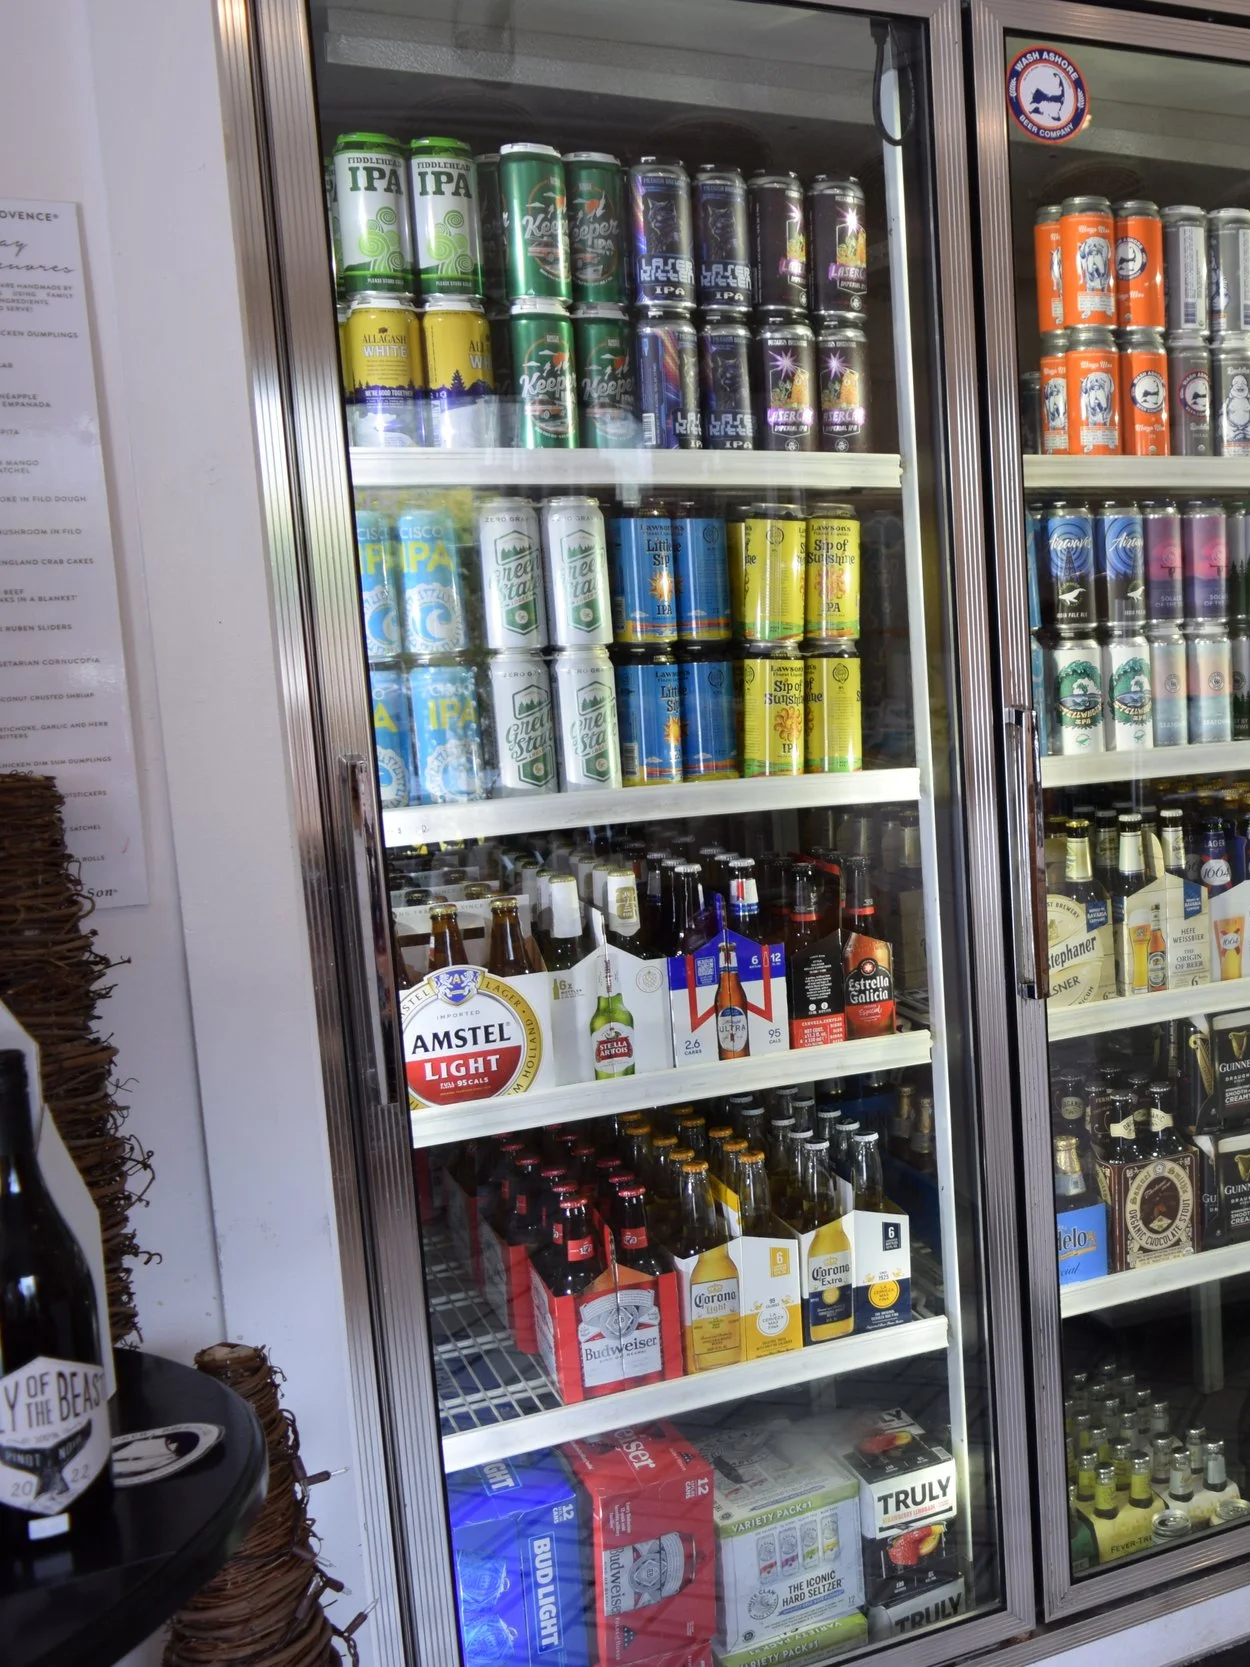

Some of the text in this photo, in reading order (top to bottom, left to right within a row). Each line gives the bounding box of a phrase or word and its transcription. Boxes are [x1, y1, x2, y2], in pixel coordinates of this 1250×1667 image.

[1015, 51, 1079, 80] WASH ASHORE
[1019, 114, 1075, 139] BEER COMPANY
[348, 166, 404, 195] IPA
[418, 170, 473, 198] IPA
[655, 286, 686, 296] IPA
[715, 291, 744, 301] IPA
[27, 330, 78, 338] DUMPLINGS
[362, 335, 408, 344] ALLAGASH
[363, 345, 409, 357] WHITE
[725, 440, 752, 449] IPA
[835, 539, 850, 552] of
[67, 557, 94, 565] CAKES
[807, 552, 856, 566] Sunshine
[774, 679, 794, 693] Sip
[427, 699, 478, 731] IPA
[1204, 838, 1225, 848] LAGER
[1202, 864, 1231, 879] 1664
[1055, 902, 1080, 919] BREWERY
[1180, 927, 1196, 935] HEFE
[1172, 934, 1204, 944] WEISSBIER
[751, 955, 759, 965] 6
[770, 952, 782, 962] 12
[1176, 952, 1203, 962] ORIGIN
[1186, 961, 1204, 969] BEER
[848, 975, 889, 991] Estrella
[485, 980, 521, 1007] LAGER
[849, 988, 889, 1004] Galicia
[436, 1009, 481, 1021] IMPORTED
[720, 1024, 746, 1033] ULTRA
[768, 1028, 782, 1038] 95
[522, 1018, 537, 1079] HOLLAND
[600, 1041, 628, 1051] STELLA
[684, 1039, 701, 1050] 2.6
[600, 1047, 628, 1057] ARTOIS
[423, 1054, 500, 1081] LIGHT
[468, 1076, 489, 1085] CALS
[1225, 1089, 1248, 1098] SMOOTH
[1129, 1198, 1191, 1247] ORGANIC CHOCOLATE STOUT
[888, 1226, 895, 1239] 6
[776, 1251, 783, 1264] 6
[811, 1263, 850, 1282] Corona
[821, 1277, 843, 1287] Extra
[694, 1290, 737, 1310] Corona
[584, 1336, 658, 1362] Budweiser
[26, 1371, 50, 1399] OF
[26, 1400, 53, 1429] THE
[5, 1450, 41, 1467] PINOT
[11, 1464, 90, 1498] 20 22
[697, 1477, 709, 1497] 12
[877, 1475, 951, 1515] TRULY
[562, 1503, 575, 1520] 12
[732, 1512, 774, 1534] VARIETY
[788, 1570, 836, 1596] THE ICONIC
[533, 1536, 559, 1647] BUD LIGHT
[782, 1590, 806, 1608] HARD
[807, 1578, 842, 1598] SELTZER
[894, 1592, 963, 1634] TRULY
